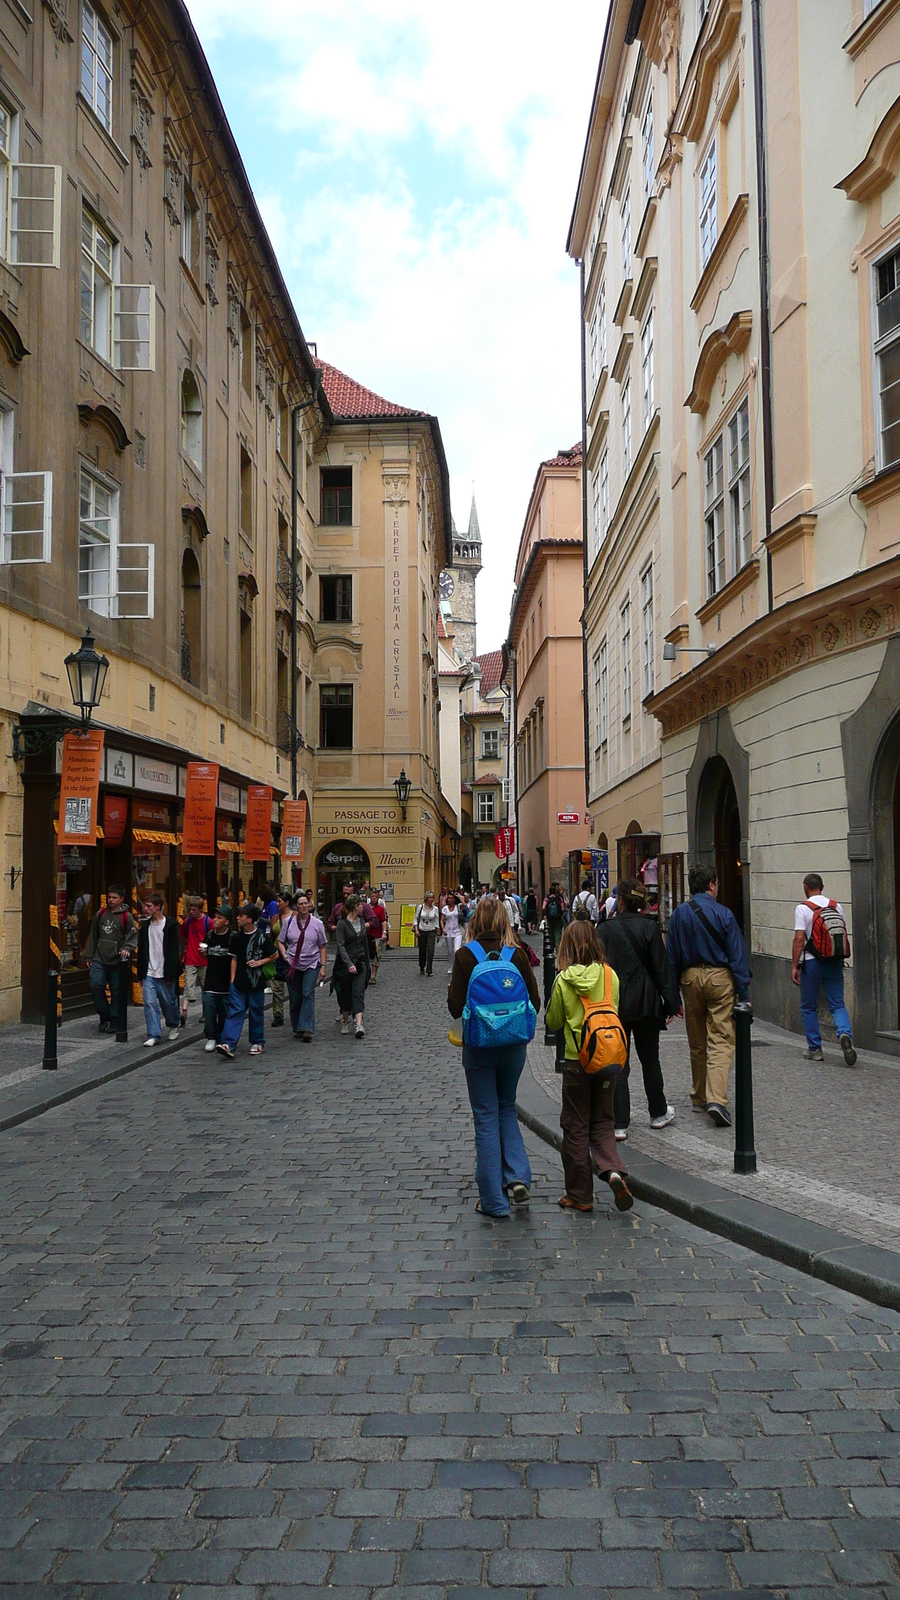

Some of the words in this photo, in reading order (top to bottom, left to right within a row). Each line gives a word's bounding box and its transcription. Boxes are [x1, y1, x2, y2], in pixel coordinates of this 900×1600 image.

[334, 811, 380, 819] PASSAGE
[382, 811, 396, 819] TO
[317, 826, 339, 835] OLD
[341, 826, 370, 835] TOWN
[373, 826, 415, 835] SQUARE
[378, 854, 414, 866] Moser
